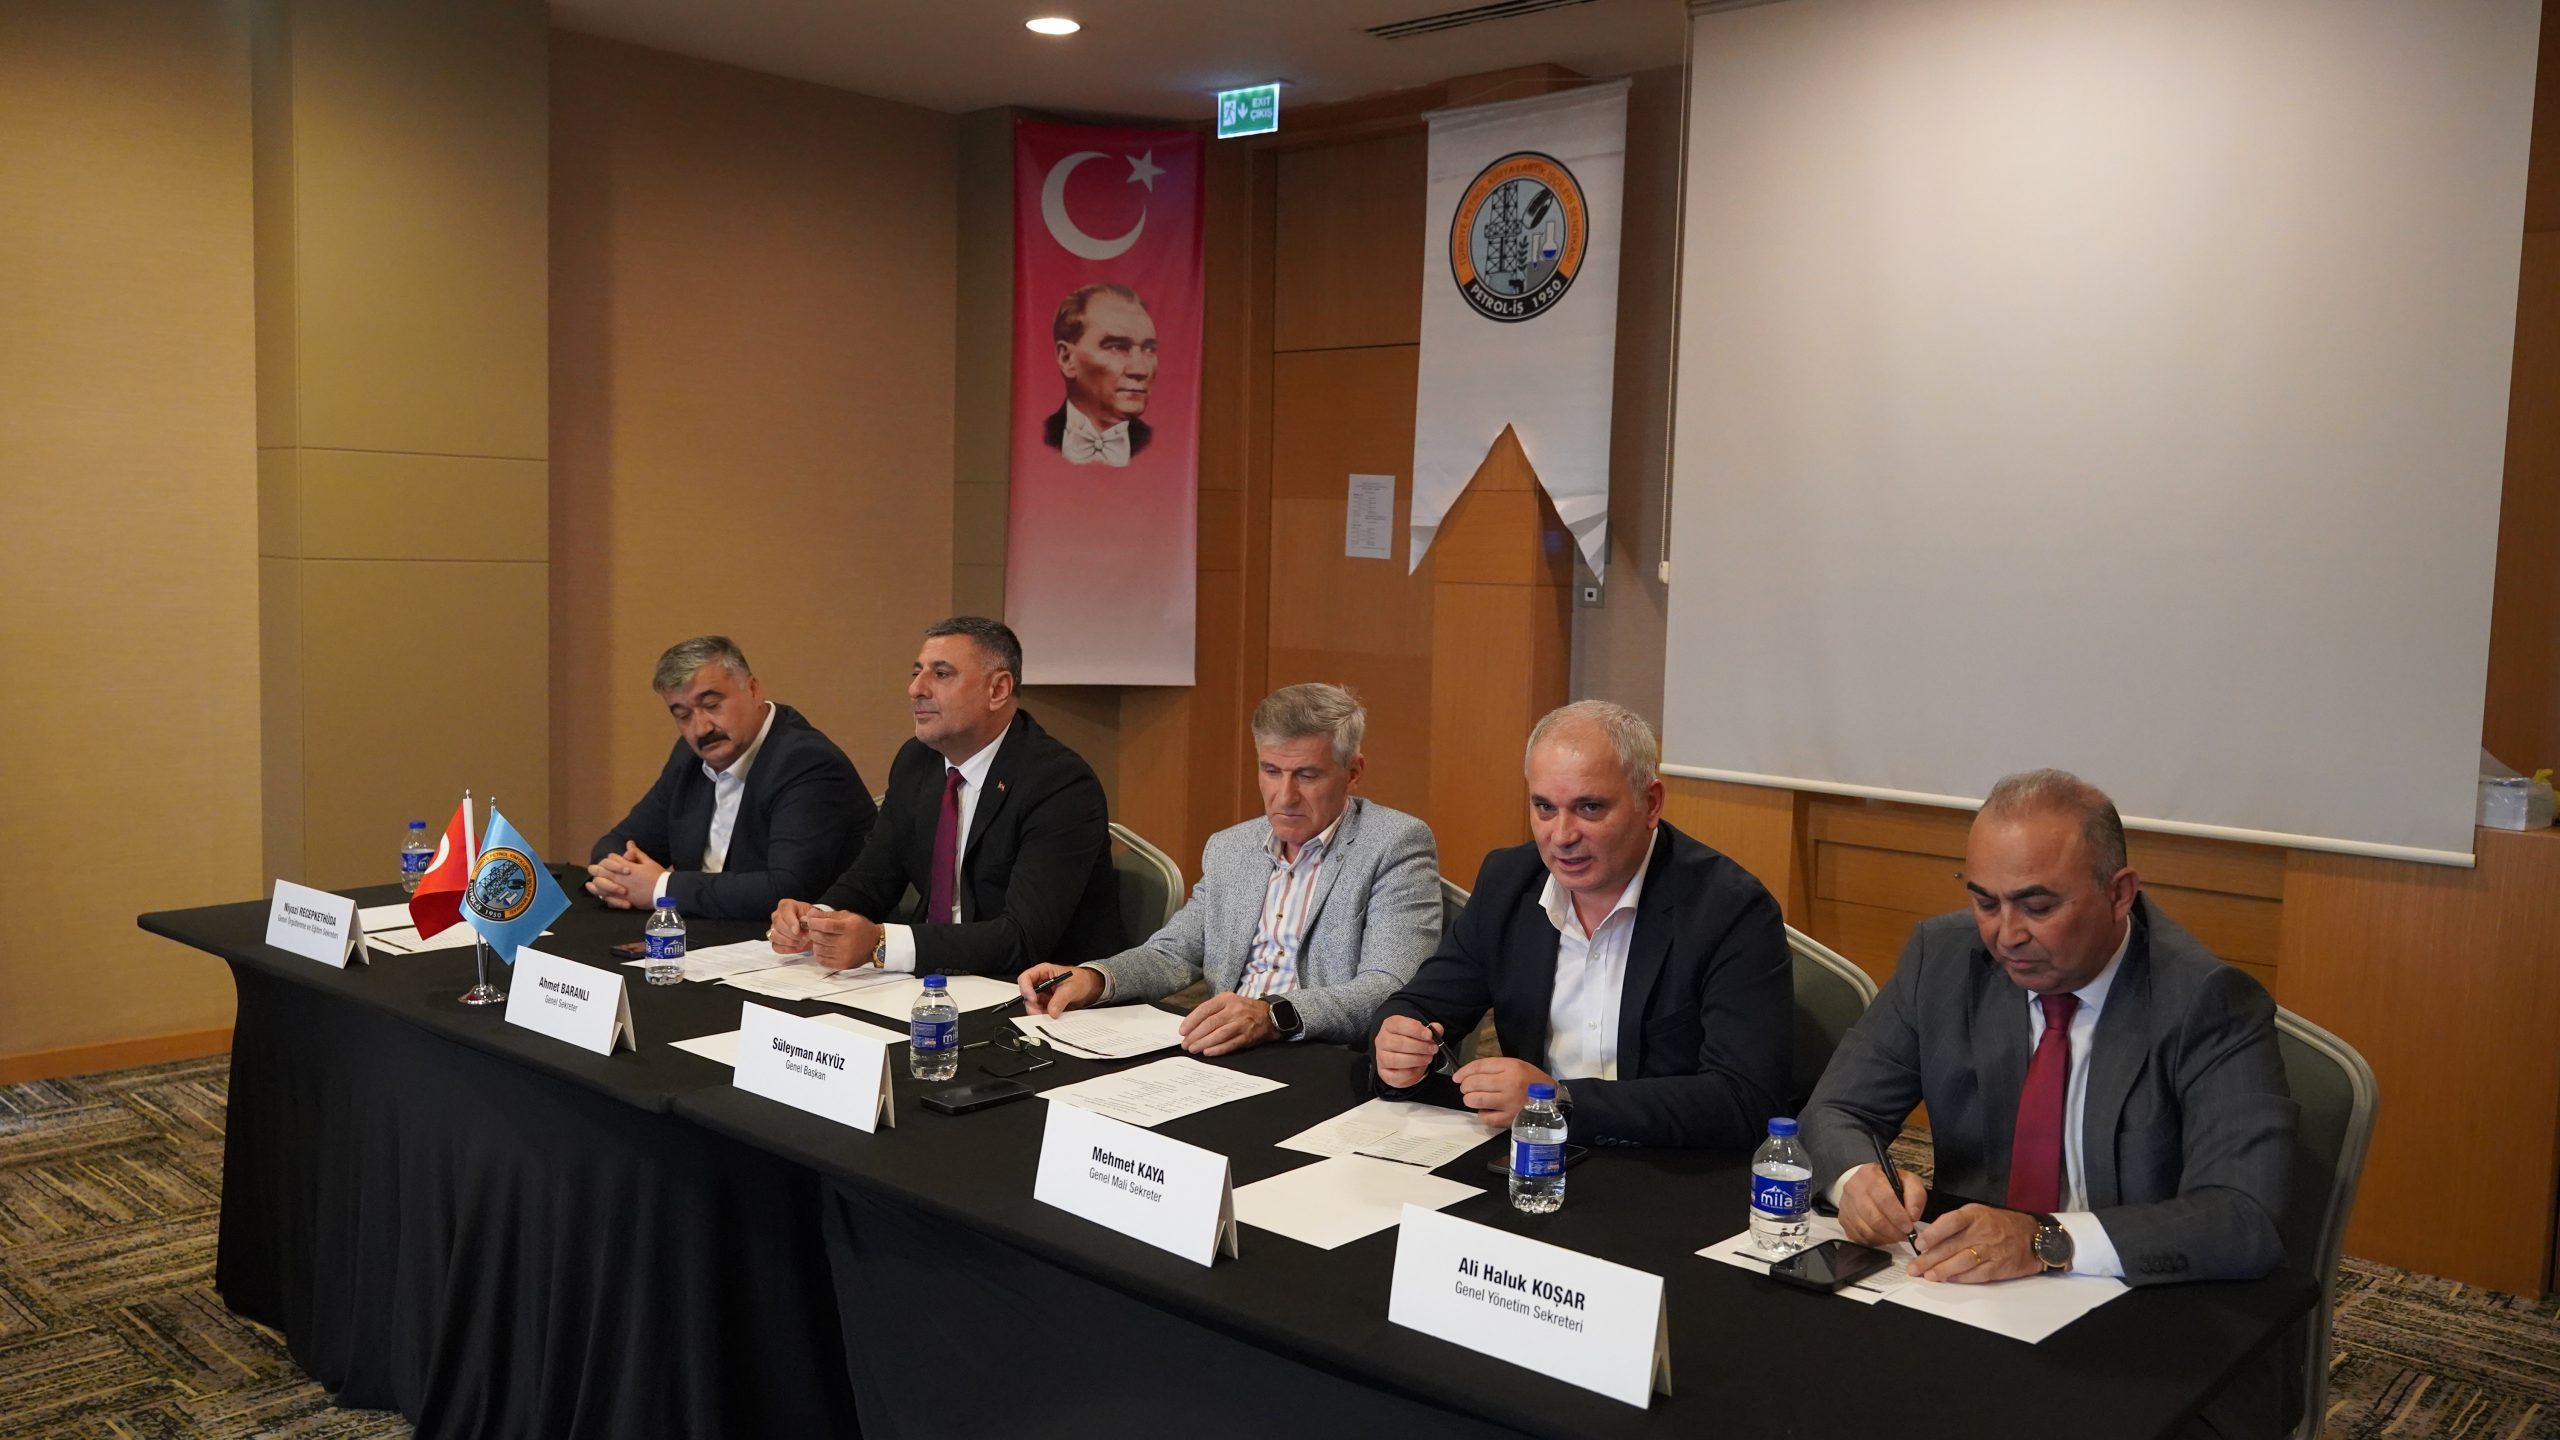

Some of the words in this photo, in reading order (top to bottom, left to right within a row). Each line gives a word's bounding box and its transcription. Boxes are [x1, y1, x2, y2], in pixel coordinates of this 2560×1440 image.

[1252, 97, 1271, 108] EXIT
[1471, 284, 1524, 315] PETROL-İŞ
[1532, 279, 1561, 308] 1950
[284, 902, 299, 915] Niyazi
[485, 909, 502, 918] 1950
[664, 944, 683, 954] mila
[539, 976, 560, 992] Ahmet
[560, 983, 590, 1001] BARANLI
[545, 994, 558, 1006] Genel
[558, 998, 578, 1012] Sekreter
[772, 1037, 814, 1061] Süleyman
[815, 1051, 845, 1071] AKYÜZ
[785, 1059, 803, 1073] Genel
[803, 1065, 826, 1080] Başkan
[1092, 1146, 1135, 1174] Mehmet
[1137, 1162, 1164, 1185] KAYA
[1089, 1167, 1110, 1184] Genel
[1112, 1175, 1127, 1190] Mali
[1129, 1182, 1162, 1202] Sekreter
[1761, 1193, 1793, 1208] mila
[1458, 1257, 1479, 1277] Ali
[1483, 1264, 1527, 1293] Haluk
[1532, 1278, 1585, 1311] KOŞAR
[1455, 1281, 1485, 1301] Genel
[1488, 1290, 1530, 1315] Yönetim
[1533, 1305, 1583, 1333] Sekreteri
